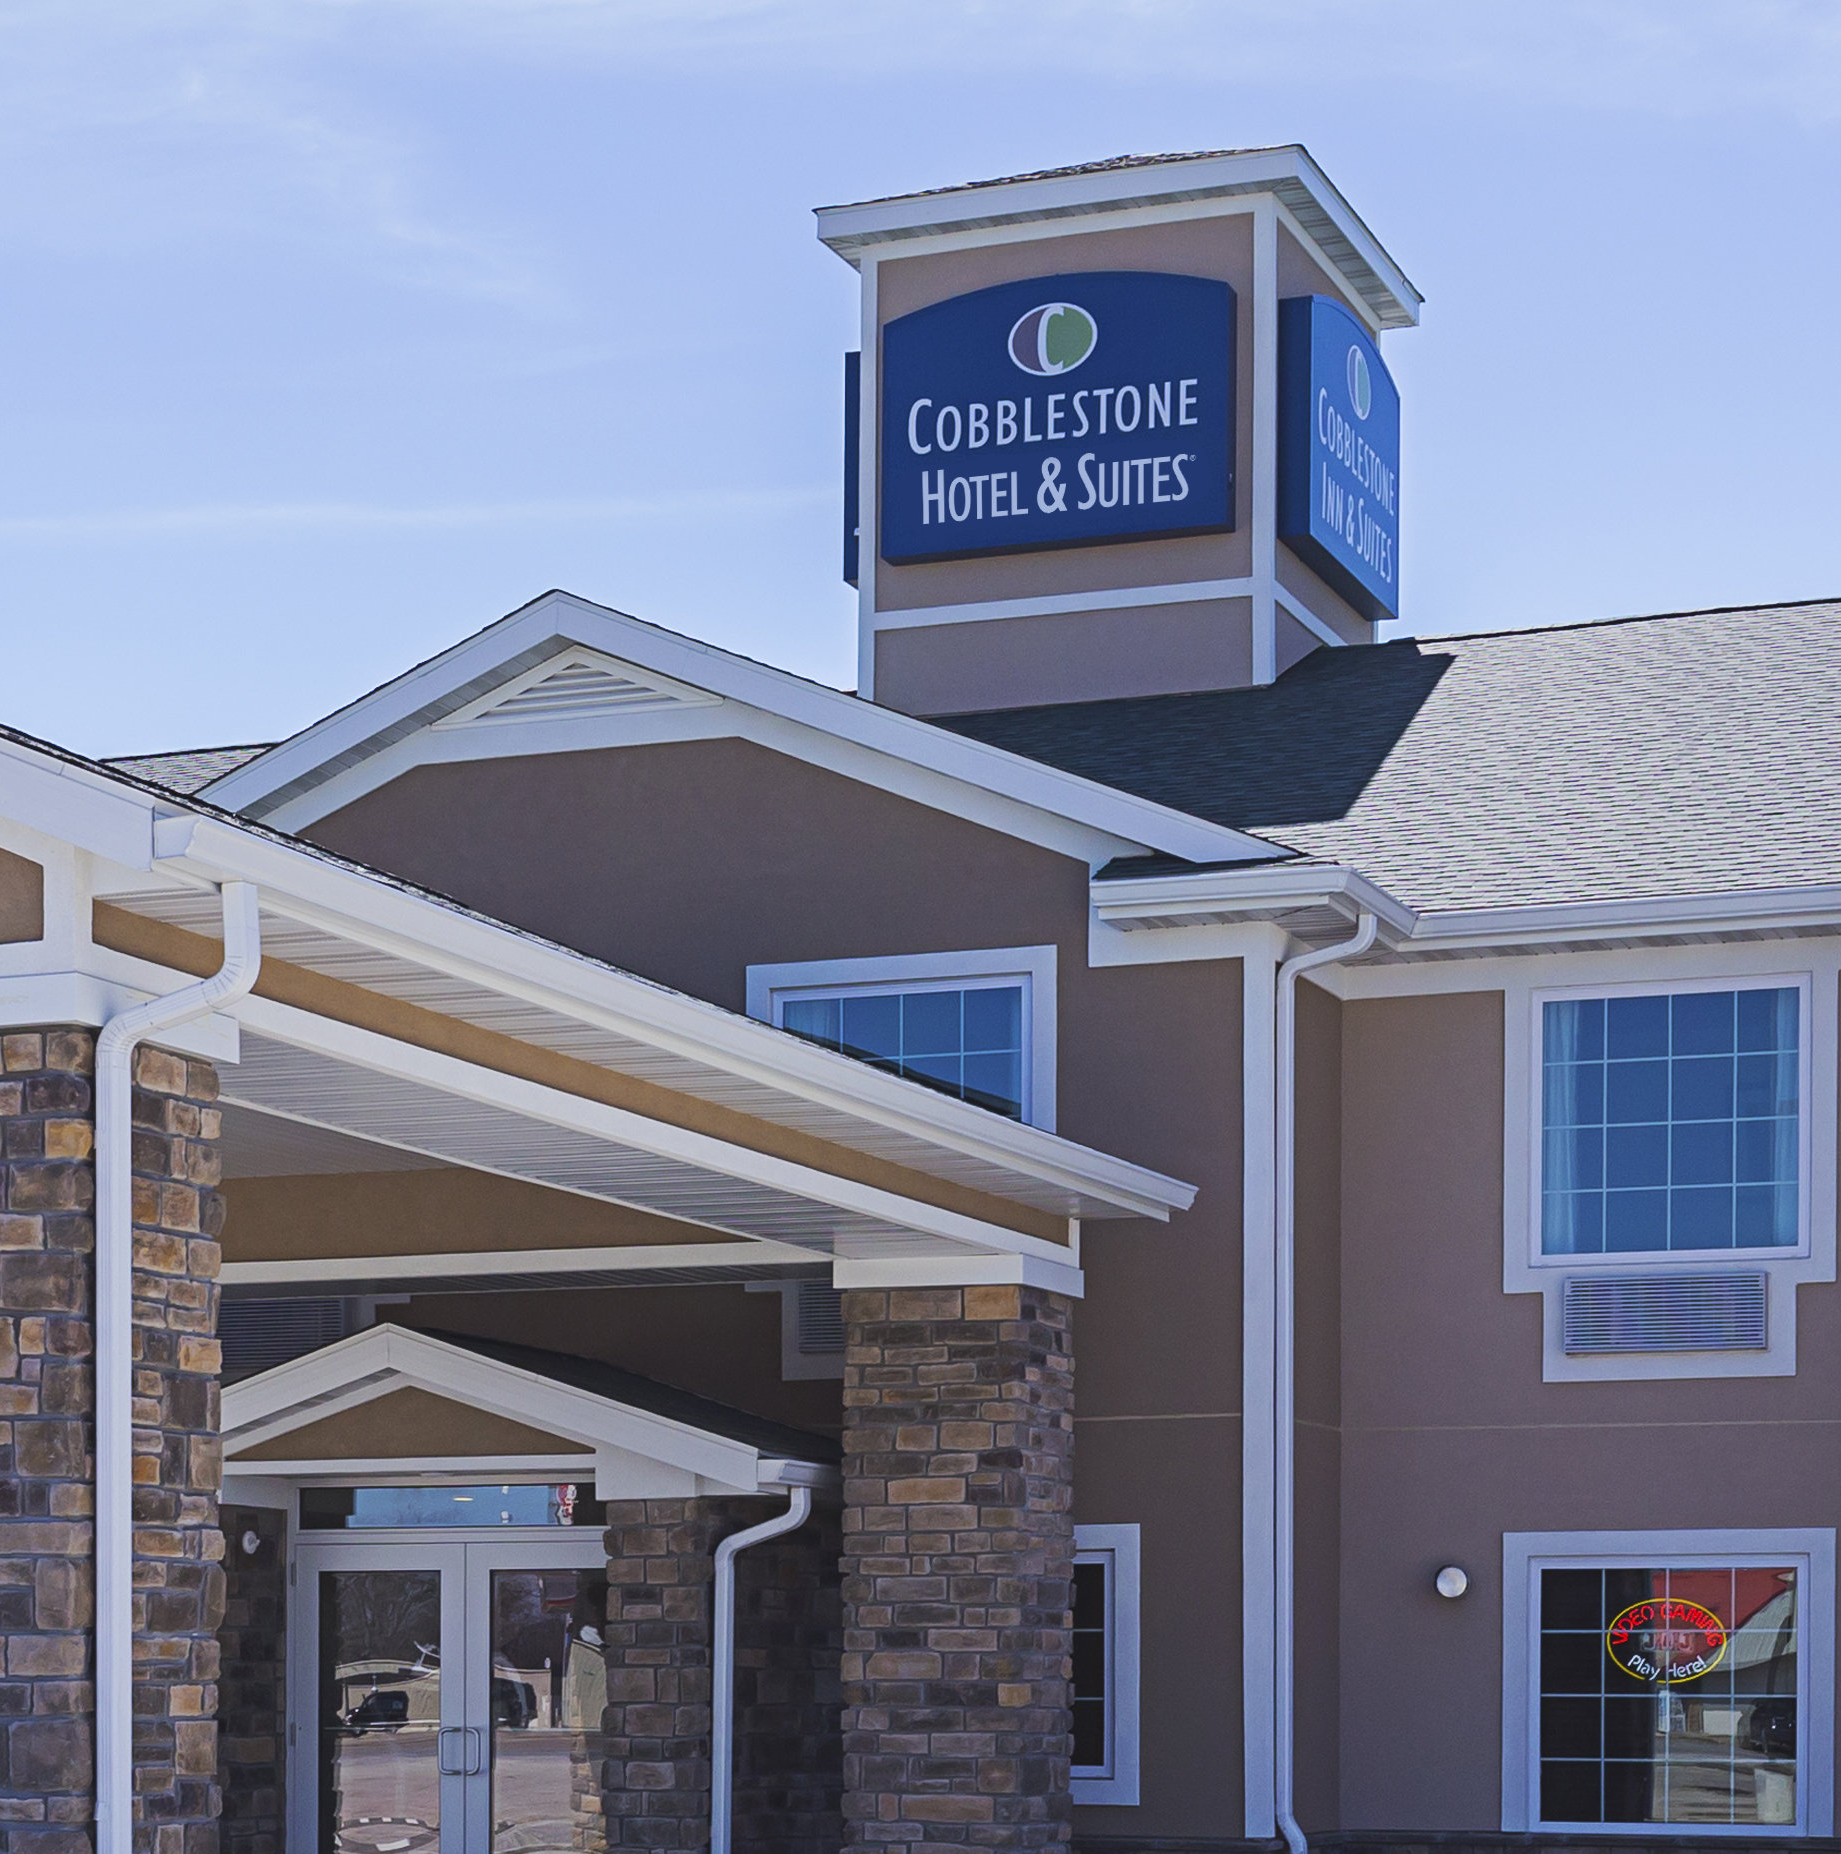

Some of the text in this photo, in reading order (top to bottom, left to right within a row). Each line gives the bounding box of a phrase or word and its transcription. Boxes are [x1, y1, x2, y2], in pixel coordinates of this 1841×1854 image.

[907, 378, 1199, 455] COBBLESTONE
[1318, 386, 1395, 517] COBBLESTONE
[921, 452, 1190, 525] HOTEL & SUITES
[1321, 461, 1393, 584] INN & SUITES
[1660, 1604, 1723, 1647] GAMING
[1627, 1654, 1708, 1681] Play Here!
